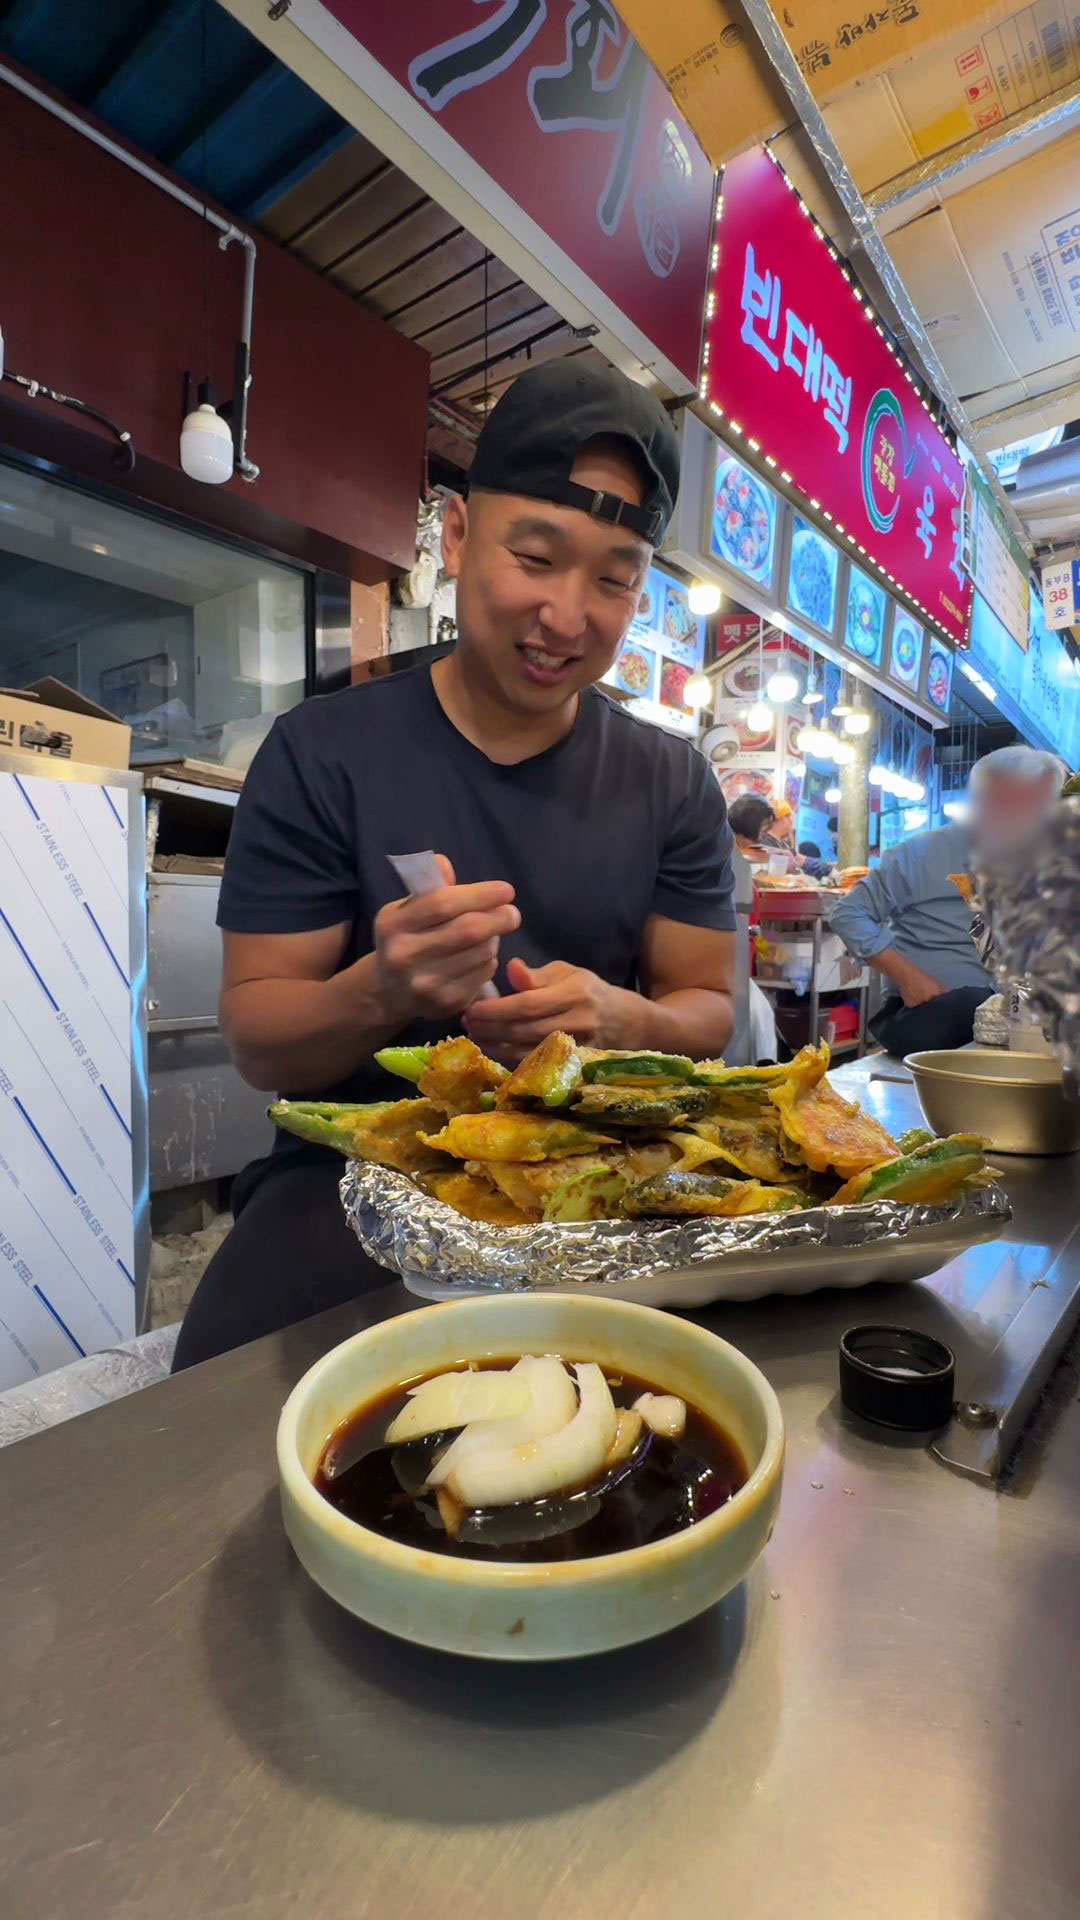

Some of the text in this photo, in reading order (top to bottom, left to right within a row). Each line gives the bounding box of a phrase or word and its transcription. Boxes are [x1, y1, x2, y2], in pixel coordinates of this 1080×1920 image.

[741, 242, 852, 455] 빈대떡
[1049, 588, 1068, 603] 38
[36, 822, 84, 902] STAINLESS STEEL
[56, 1012, 100, 1086] STAINLESS STEEL
[73, 1195, 117, 1262] STAINLESS STEEL
[13, 1260, 33, 1288] STEEL
